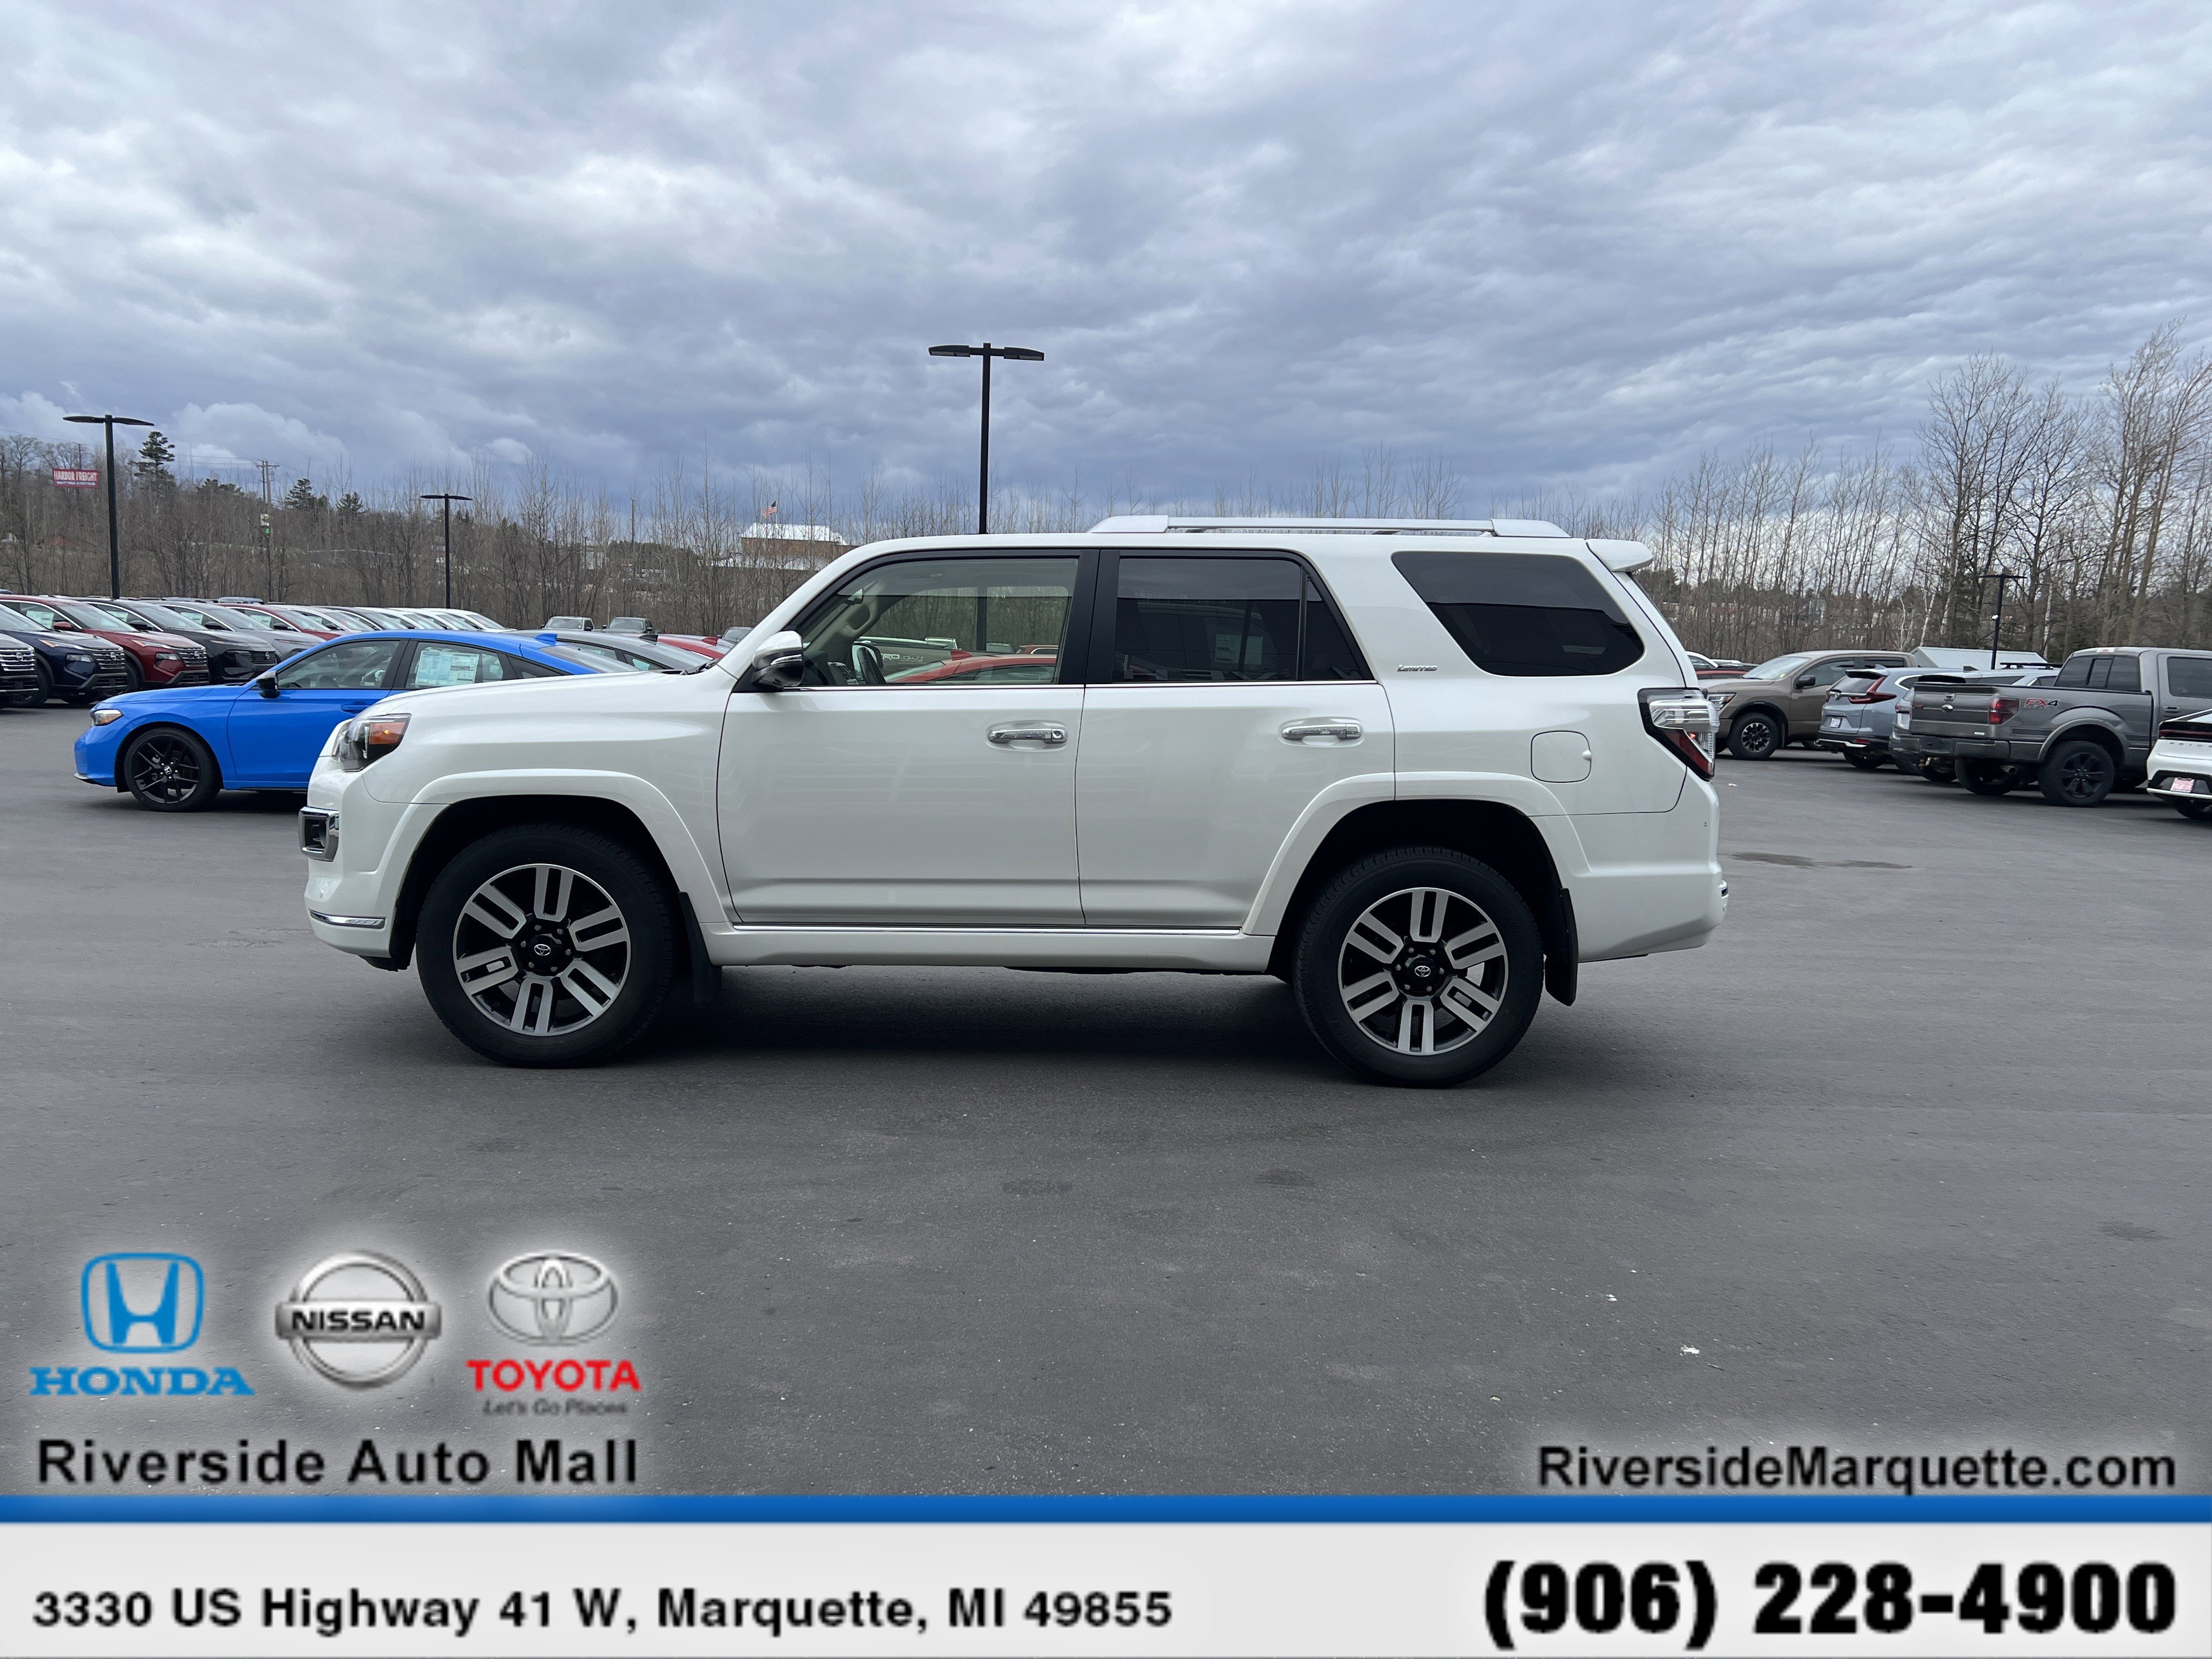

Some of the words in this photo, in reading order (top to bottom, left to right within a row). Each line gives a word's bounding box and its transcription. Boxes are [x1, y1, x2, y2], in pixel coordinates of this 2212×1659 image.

[53, 470, 75, 481] HARBOR
[76, 471, 97, 482] FREIGHT
[2024, 697, 2060, 708] FX4
